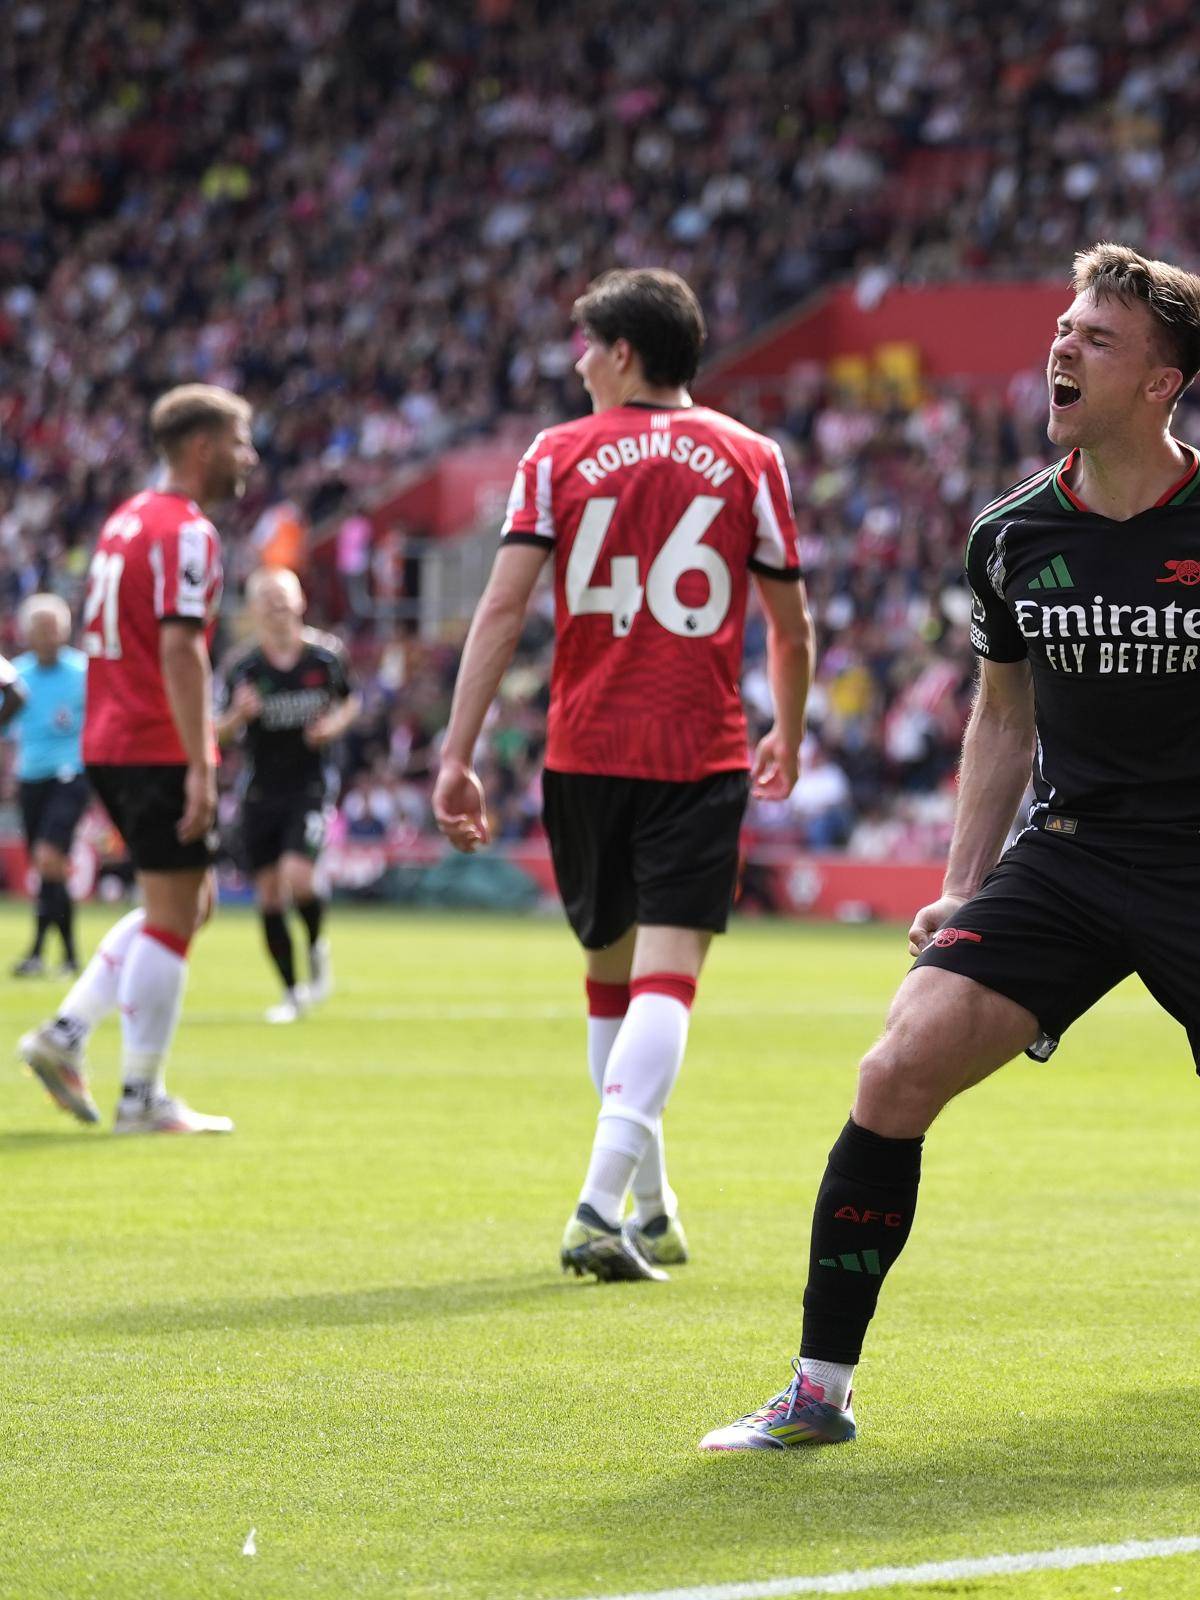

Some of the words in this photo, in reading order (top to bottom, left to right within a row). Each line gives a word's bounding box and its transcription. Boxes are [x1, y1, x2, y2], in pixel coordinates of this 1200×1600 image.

[577, 431, 734, 487] ROBINSON
[565, 494, 732, 637] 46
[1046, 643, 1086, 674] FLY
[1099, 642, 1199, 674] BETTER
[834, 1205, 903, 1228] AFC
